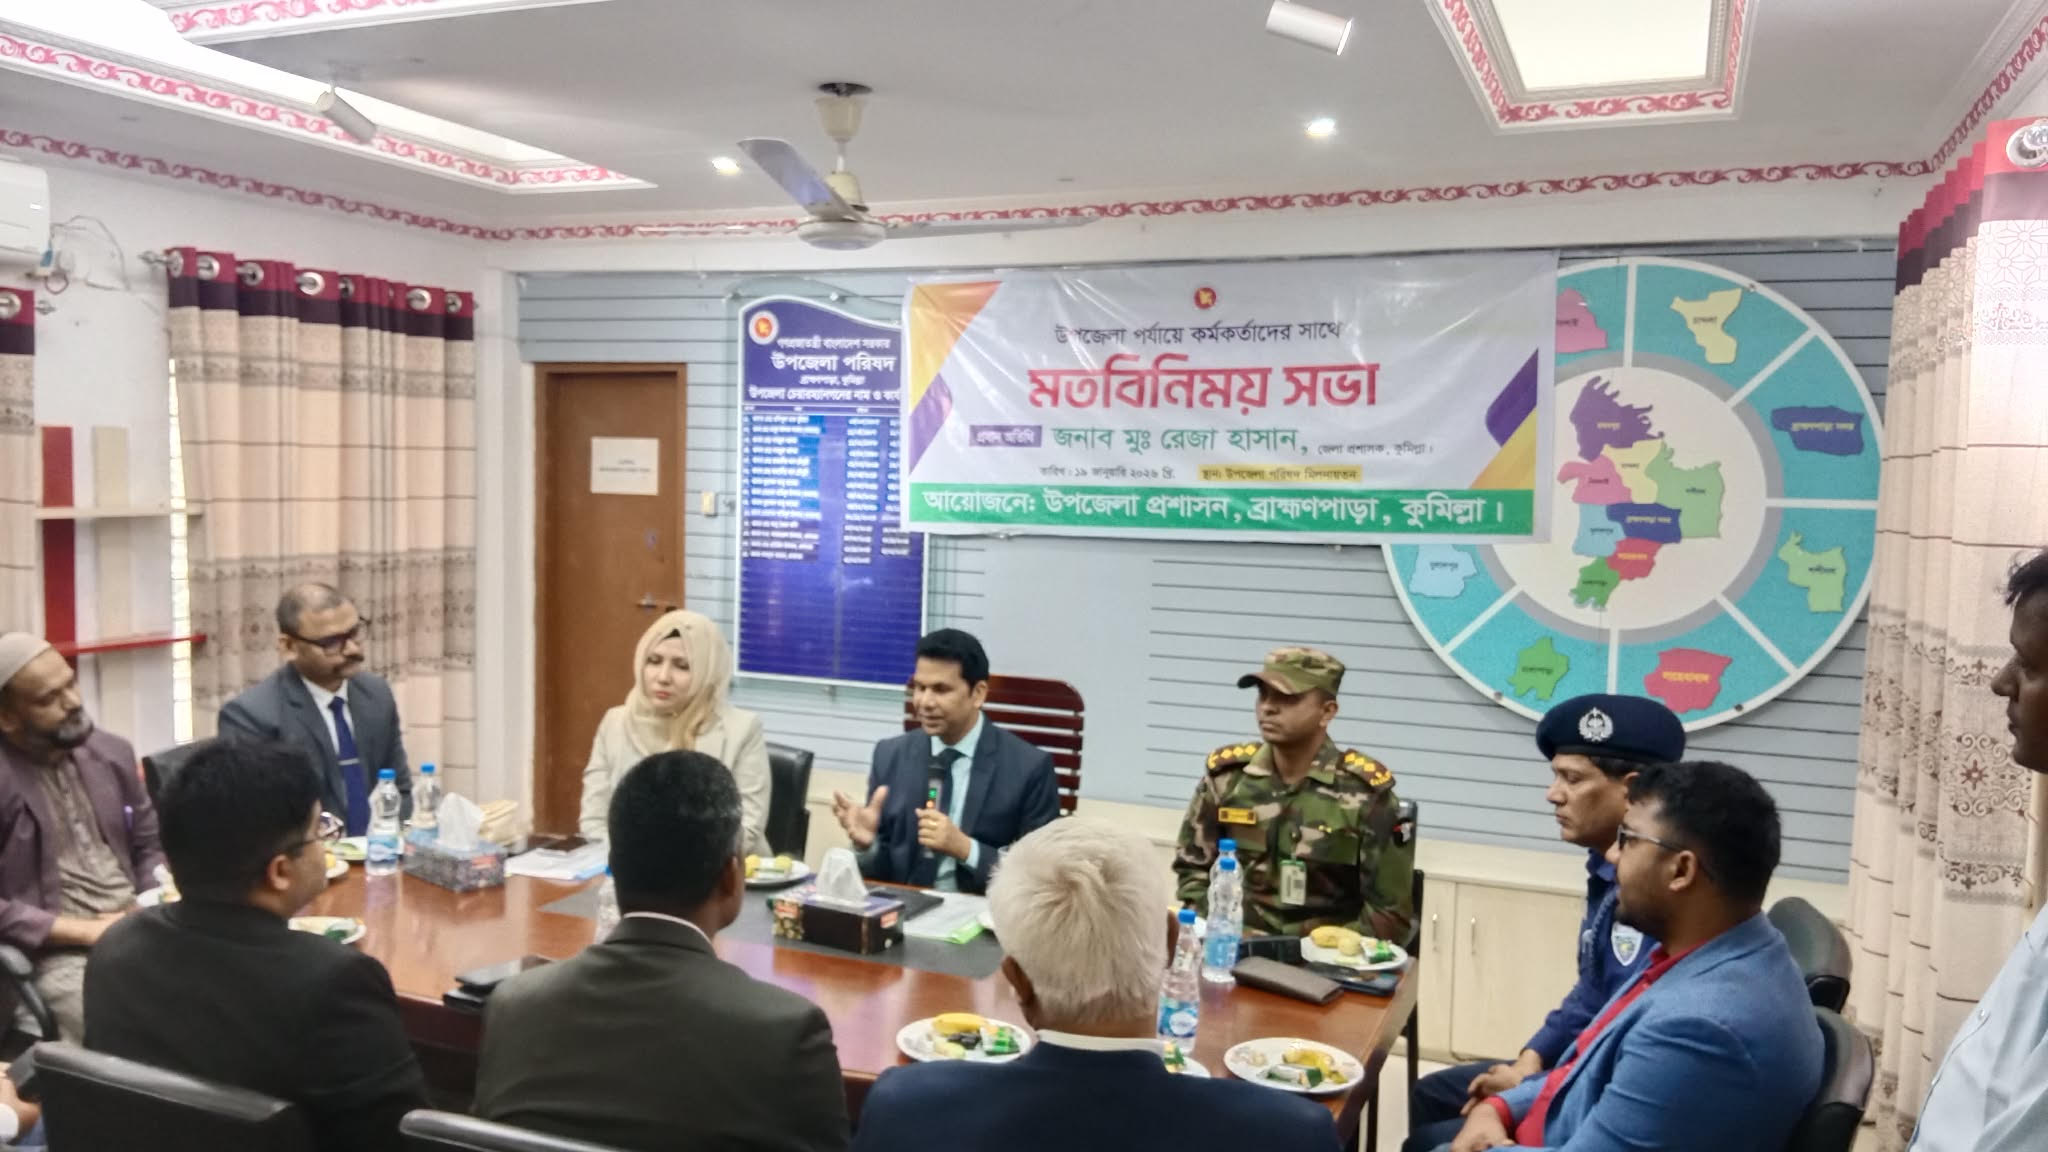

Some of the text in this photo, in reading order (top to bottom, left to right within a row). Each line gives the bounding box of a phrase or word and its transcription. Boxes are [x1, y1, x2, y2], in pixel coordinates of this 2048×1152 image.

[1055, 319, 1344, 345] উপজেলা পর্যায়ে কর্মকর্তাদের সাথে
[770, 351, 897, 371] উপজেলা পরিষদ
[1028, 353, 1380, 416] মতবিনিময় সভা
[1051, 426, 1115, 450] জনাব
[1161, 427, 1218, 451] রেজা
[1318, 443, 1343, 455] জেলা
[1225, 467, 1264, 480] উপজেলা
[1043, 487, 1140, 517] উপজেলা
[1400, 491, 1486, 528] কুমিল্লা
